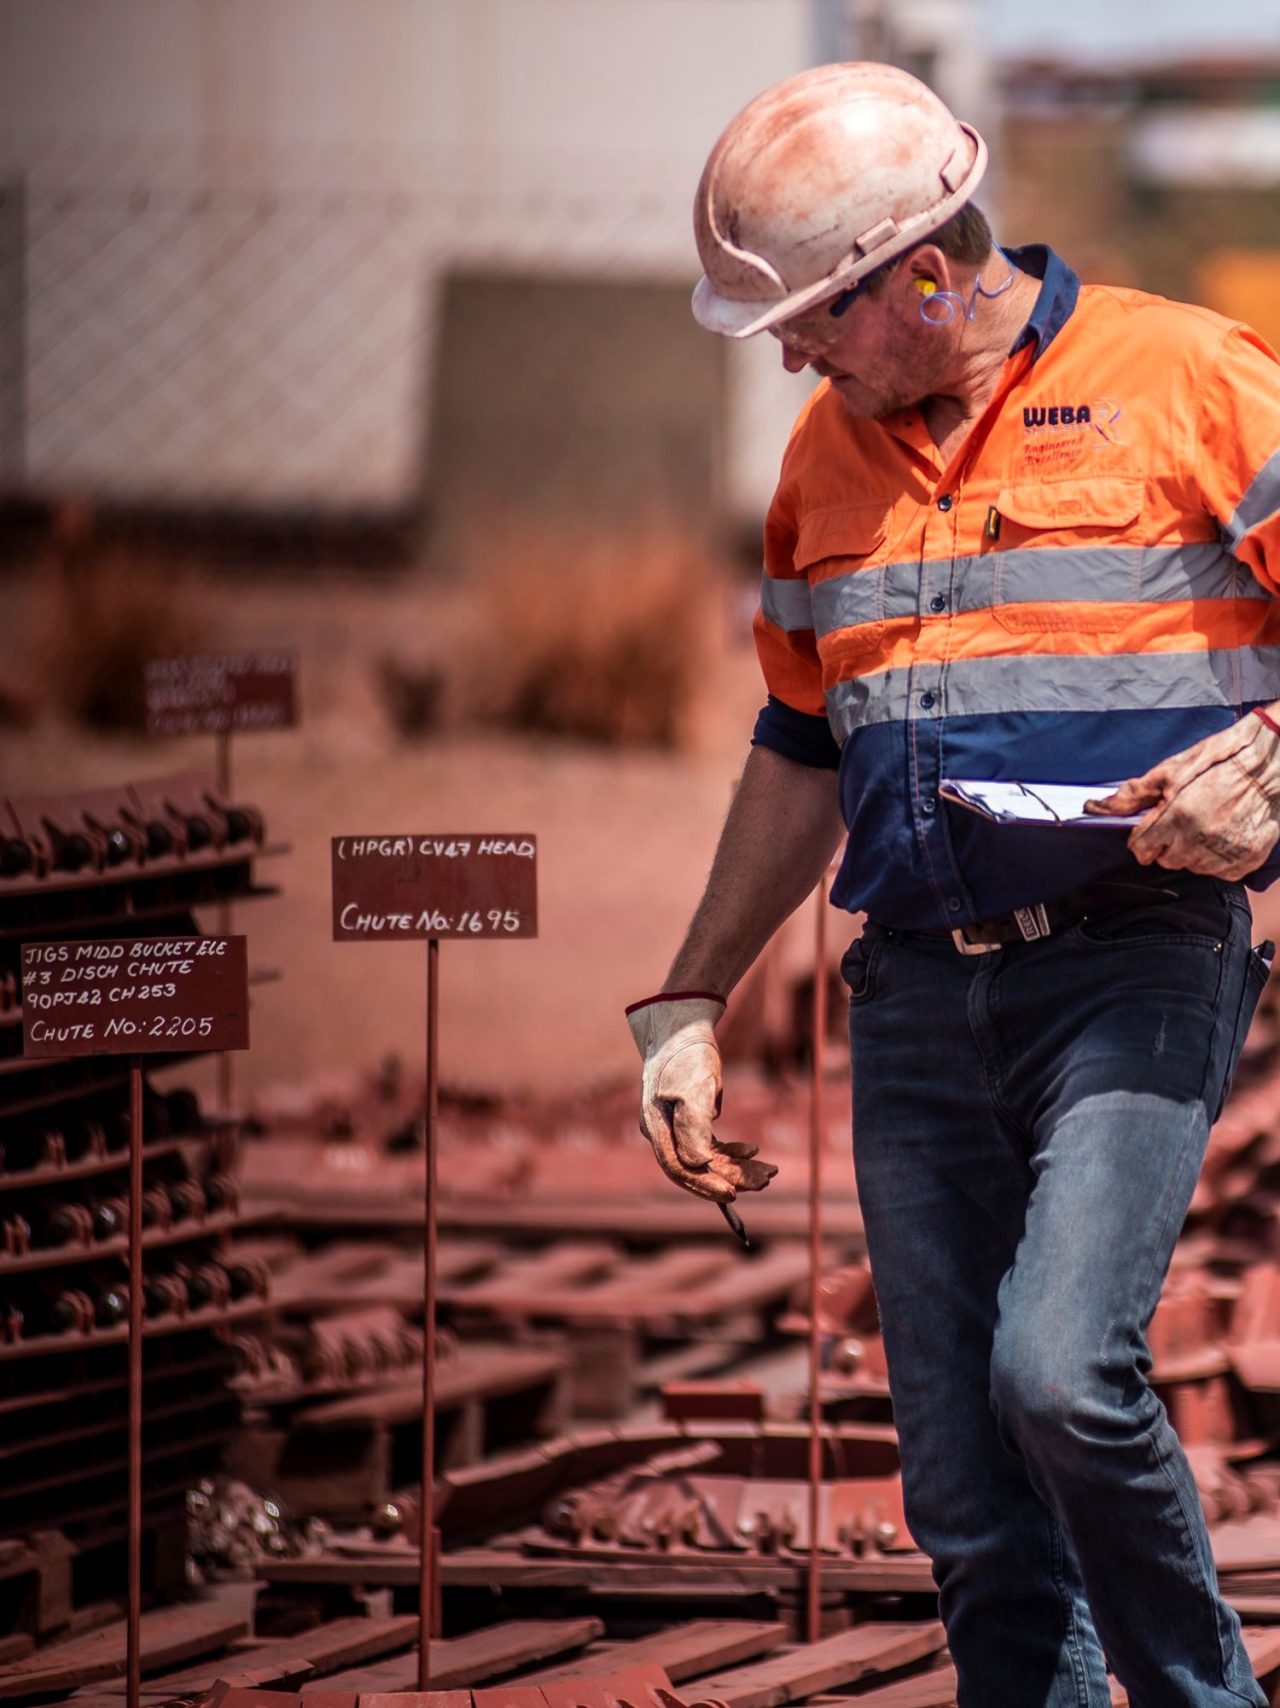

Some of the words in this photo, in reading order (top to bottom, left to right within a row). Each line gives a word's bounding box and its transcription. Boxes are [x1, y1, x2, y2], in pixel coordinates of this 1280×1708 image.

[1024, 405, 1090, 427] WEBA
[338, 837, 413, 859] (HPGR)
[477, 839, 535, 859] HEAD
[340, 902, 413, 931] CHUTE
[25, 946, 69, 964] JIGS
[75, 945, 124, 961] MIDD
[129, 940, 195, 957] BUCKET
[23, 970, 52, 986] #3
[60, 964, 119, 983] DISCH
[127, 959, 194, 978] CHUTE
[31, 1020, 95, 1042] CHUTE
